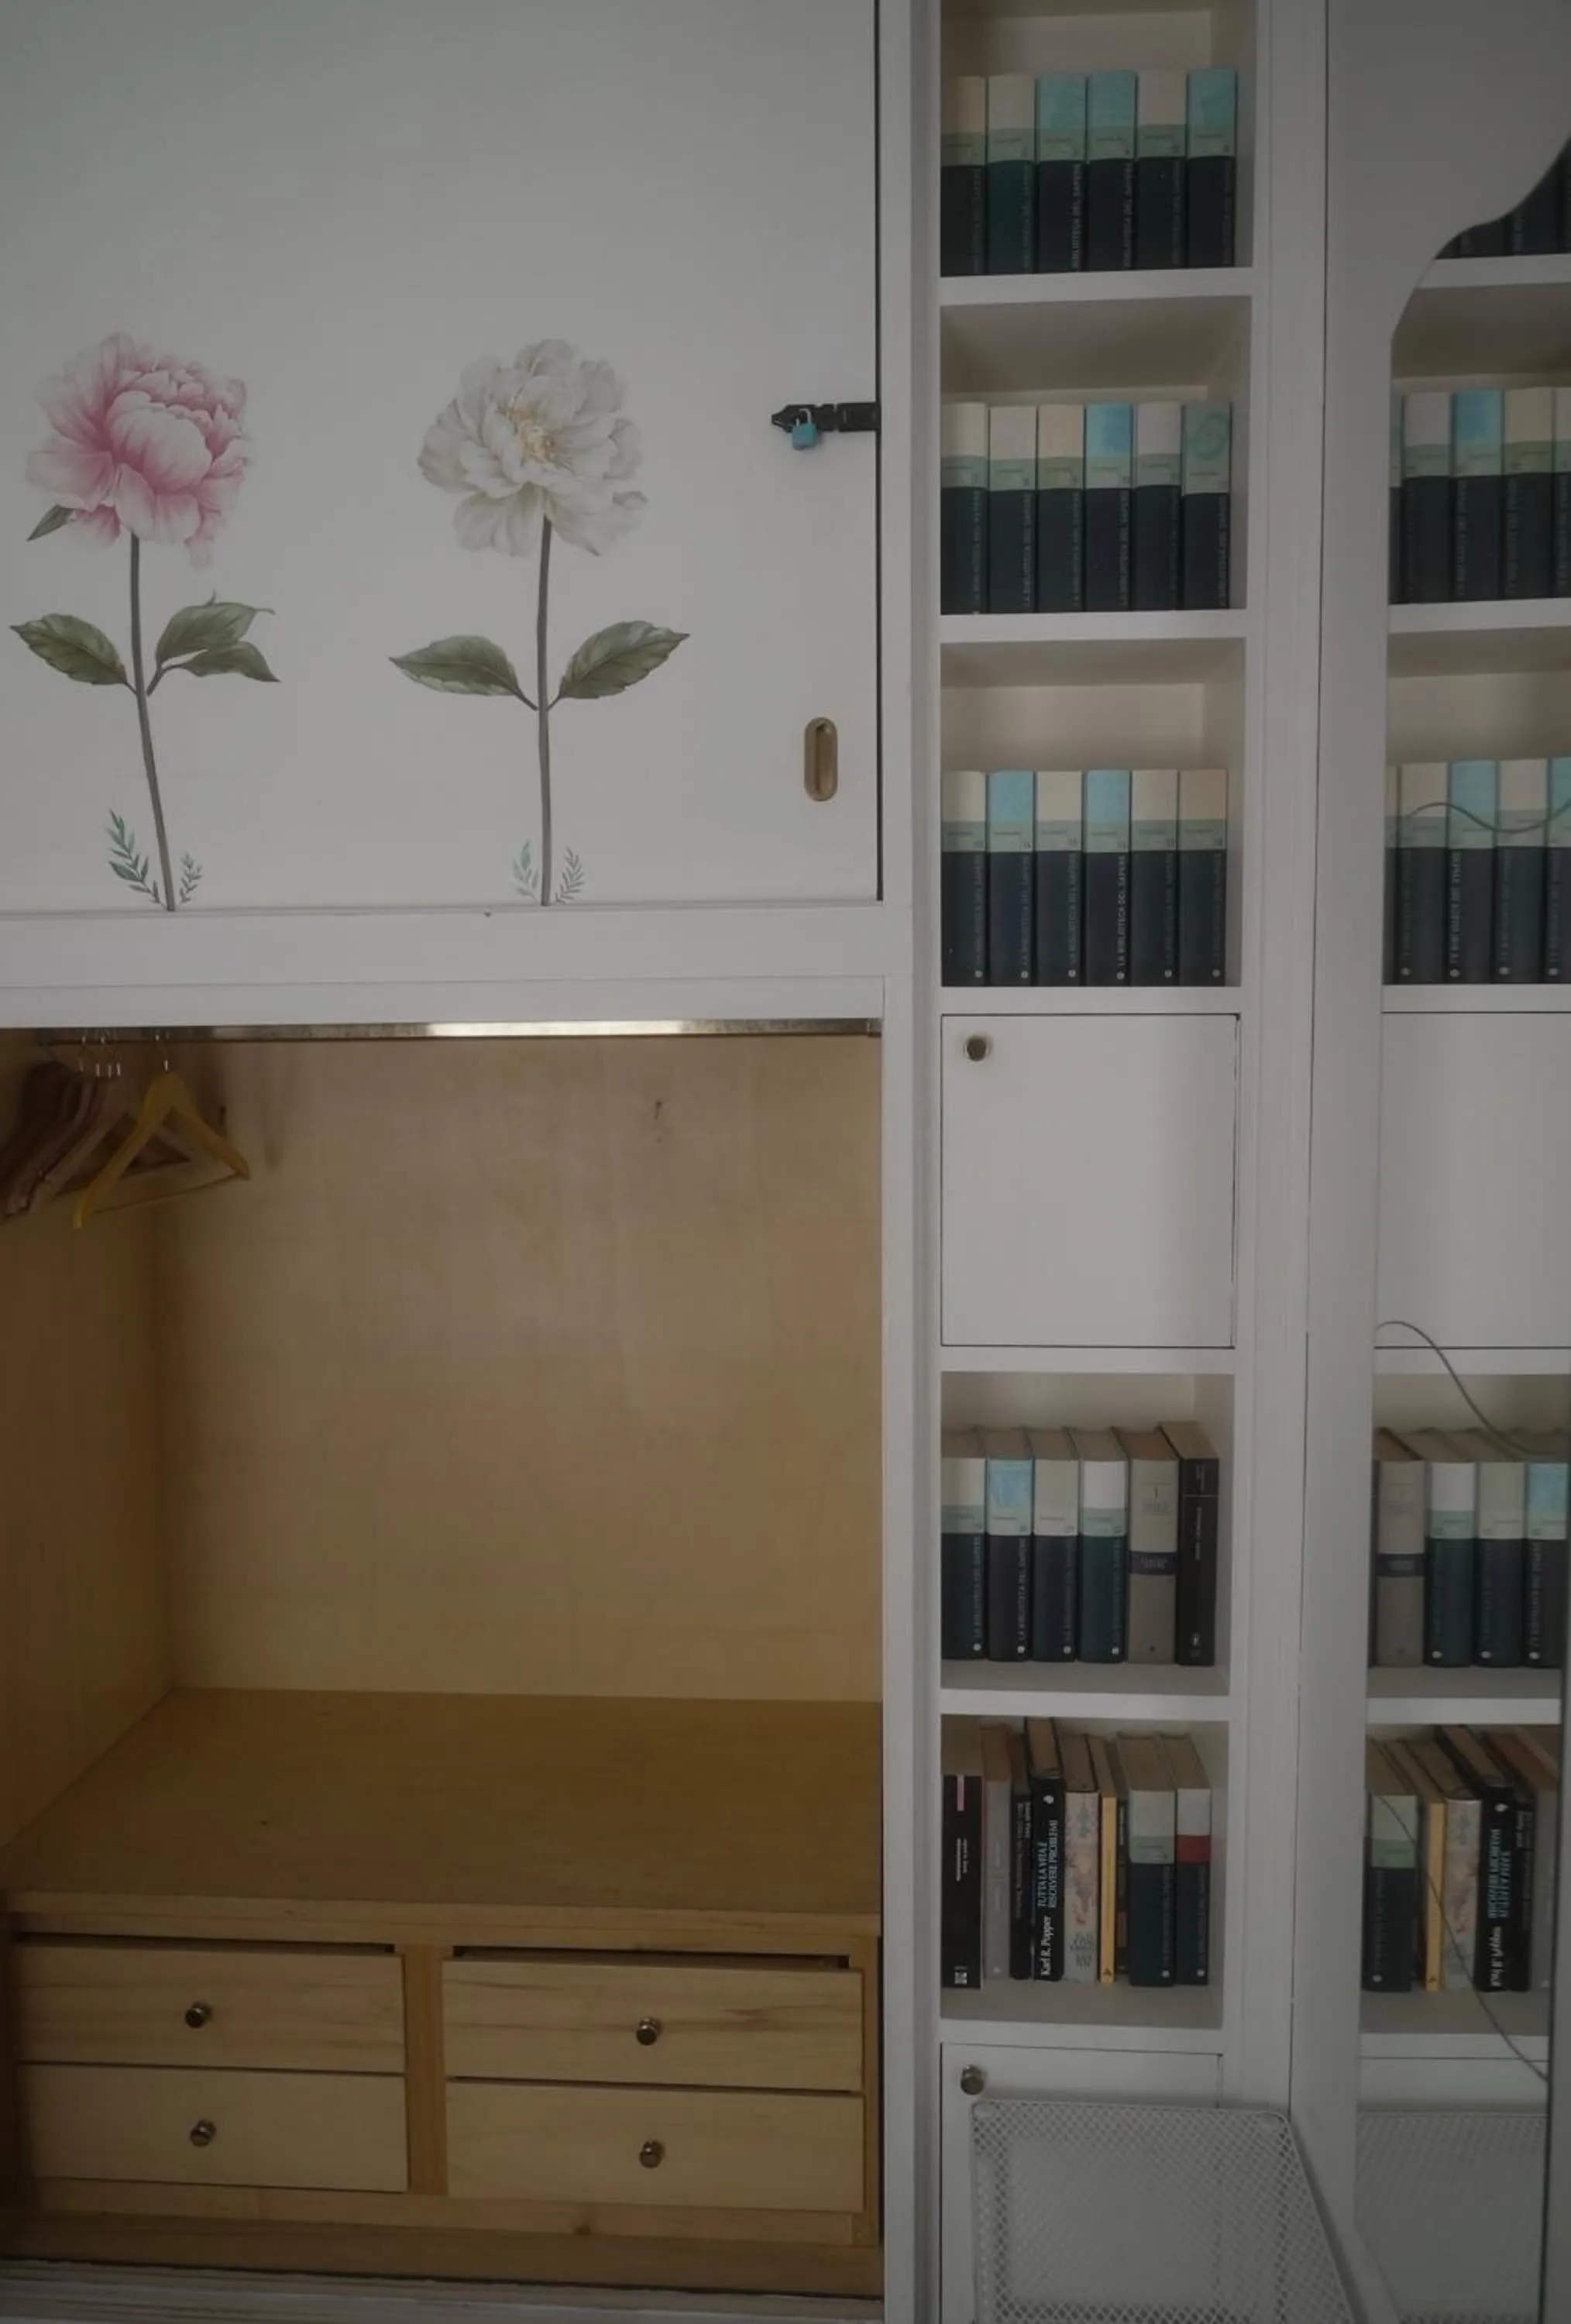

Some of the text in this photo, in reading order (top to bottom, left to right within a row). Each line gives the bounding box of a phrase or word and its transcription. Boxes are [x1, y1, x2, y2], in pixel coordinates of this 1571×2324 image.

[1040, 1915, 1054, 1975] Karl R. Popper
